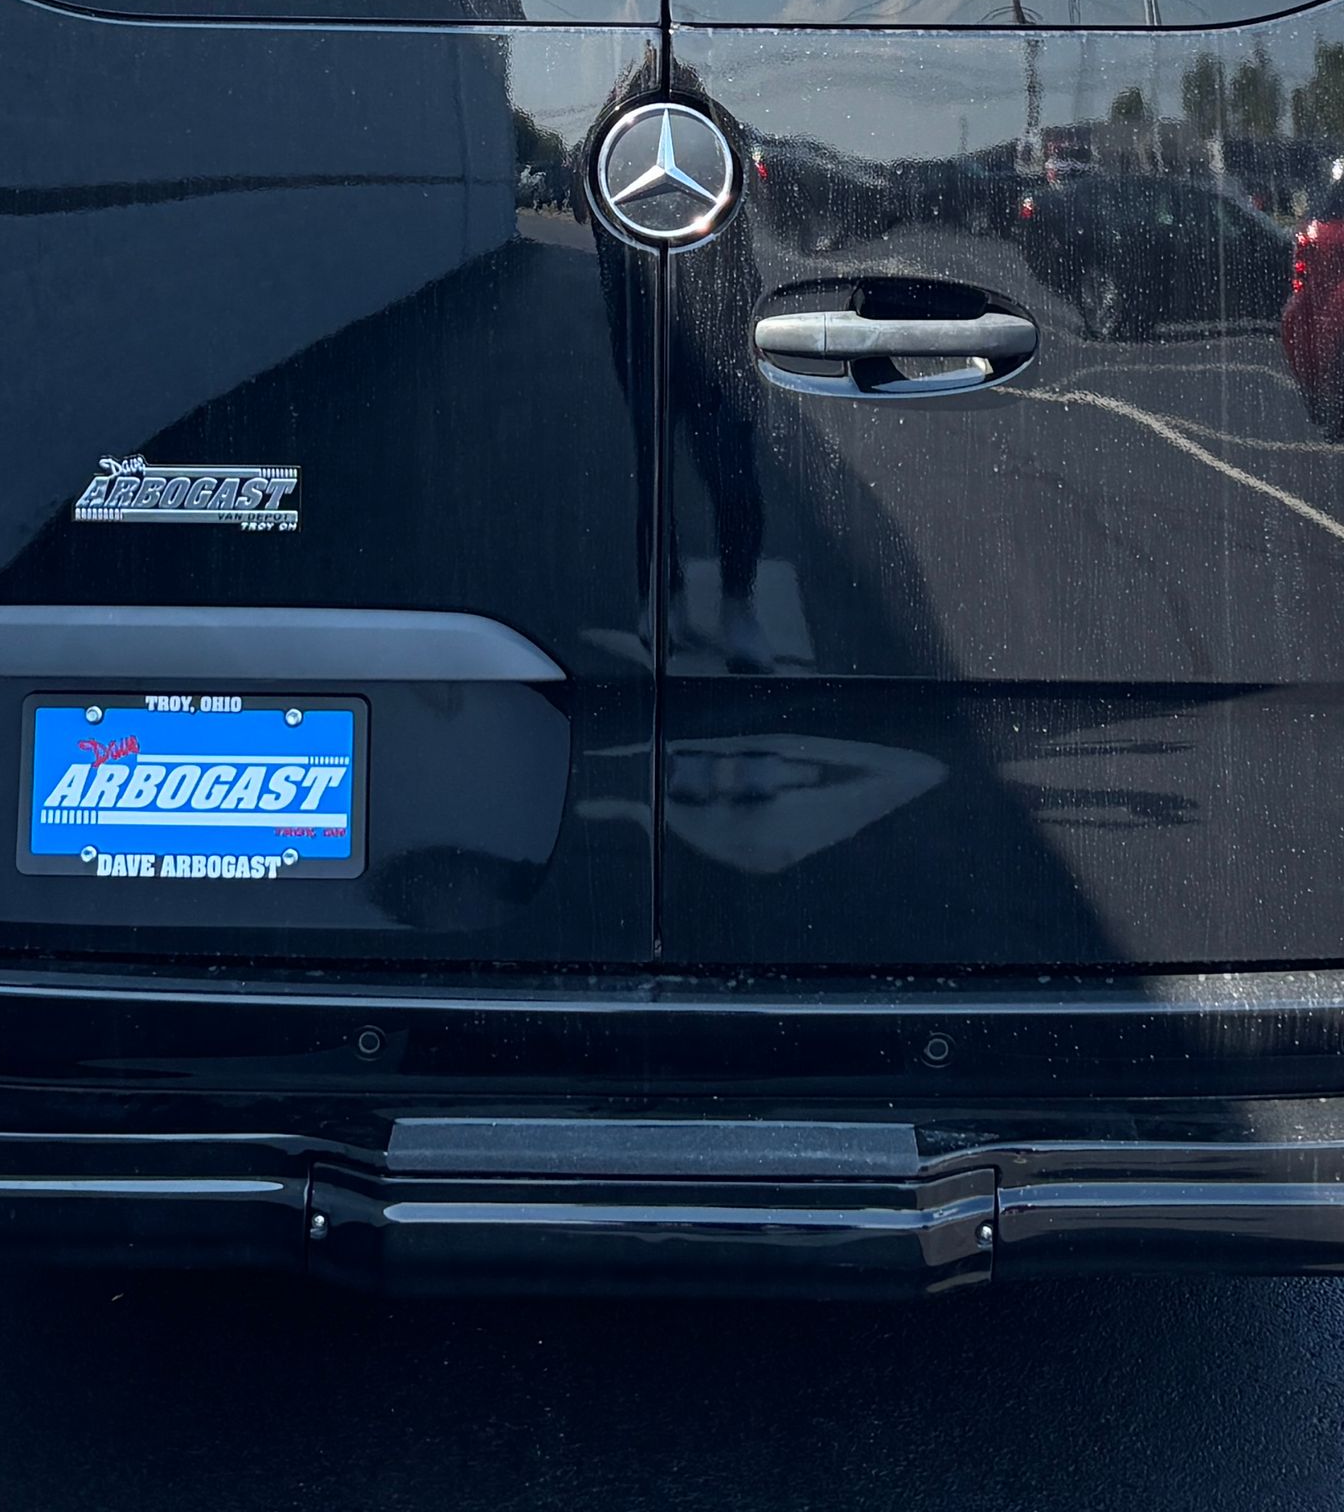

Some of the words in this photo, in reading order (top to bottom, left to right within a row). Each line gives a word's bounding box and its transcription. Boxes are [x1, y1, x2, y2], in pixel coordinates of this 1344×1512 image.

[75, 476, 298, 510] ARBOGAST
[218, 512, 243, 521] VAN
[247, 512, 289, 522] DEPOT
[240, 522, 274, 531] TROY
[145, 696, 195, 714] TROY,
[200, 696, 242, 712] OHIO
[44, 764, 348, 810] ARBOGAST
[97, 854, 155, 876] DAVE
[160, 854, 282, 879] ARBOGAST
